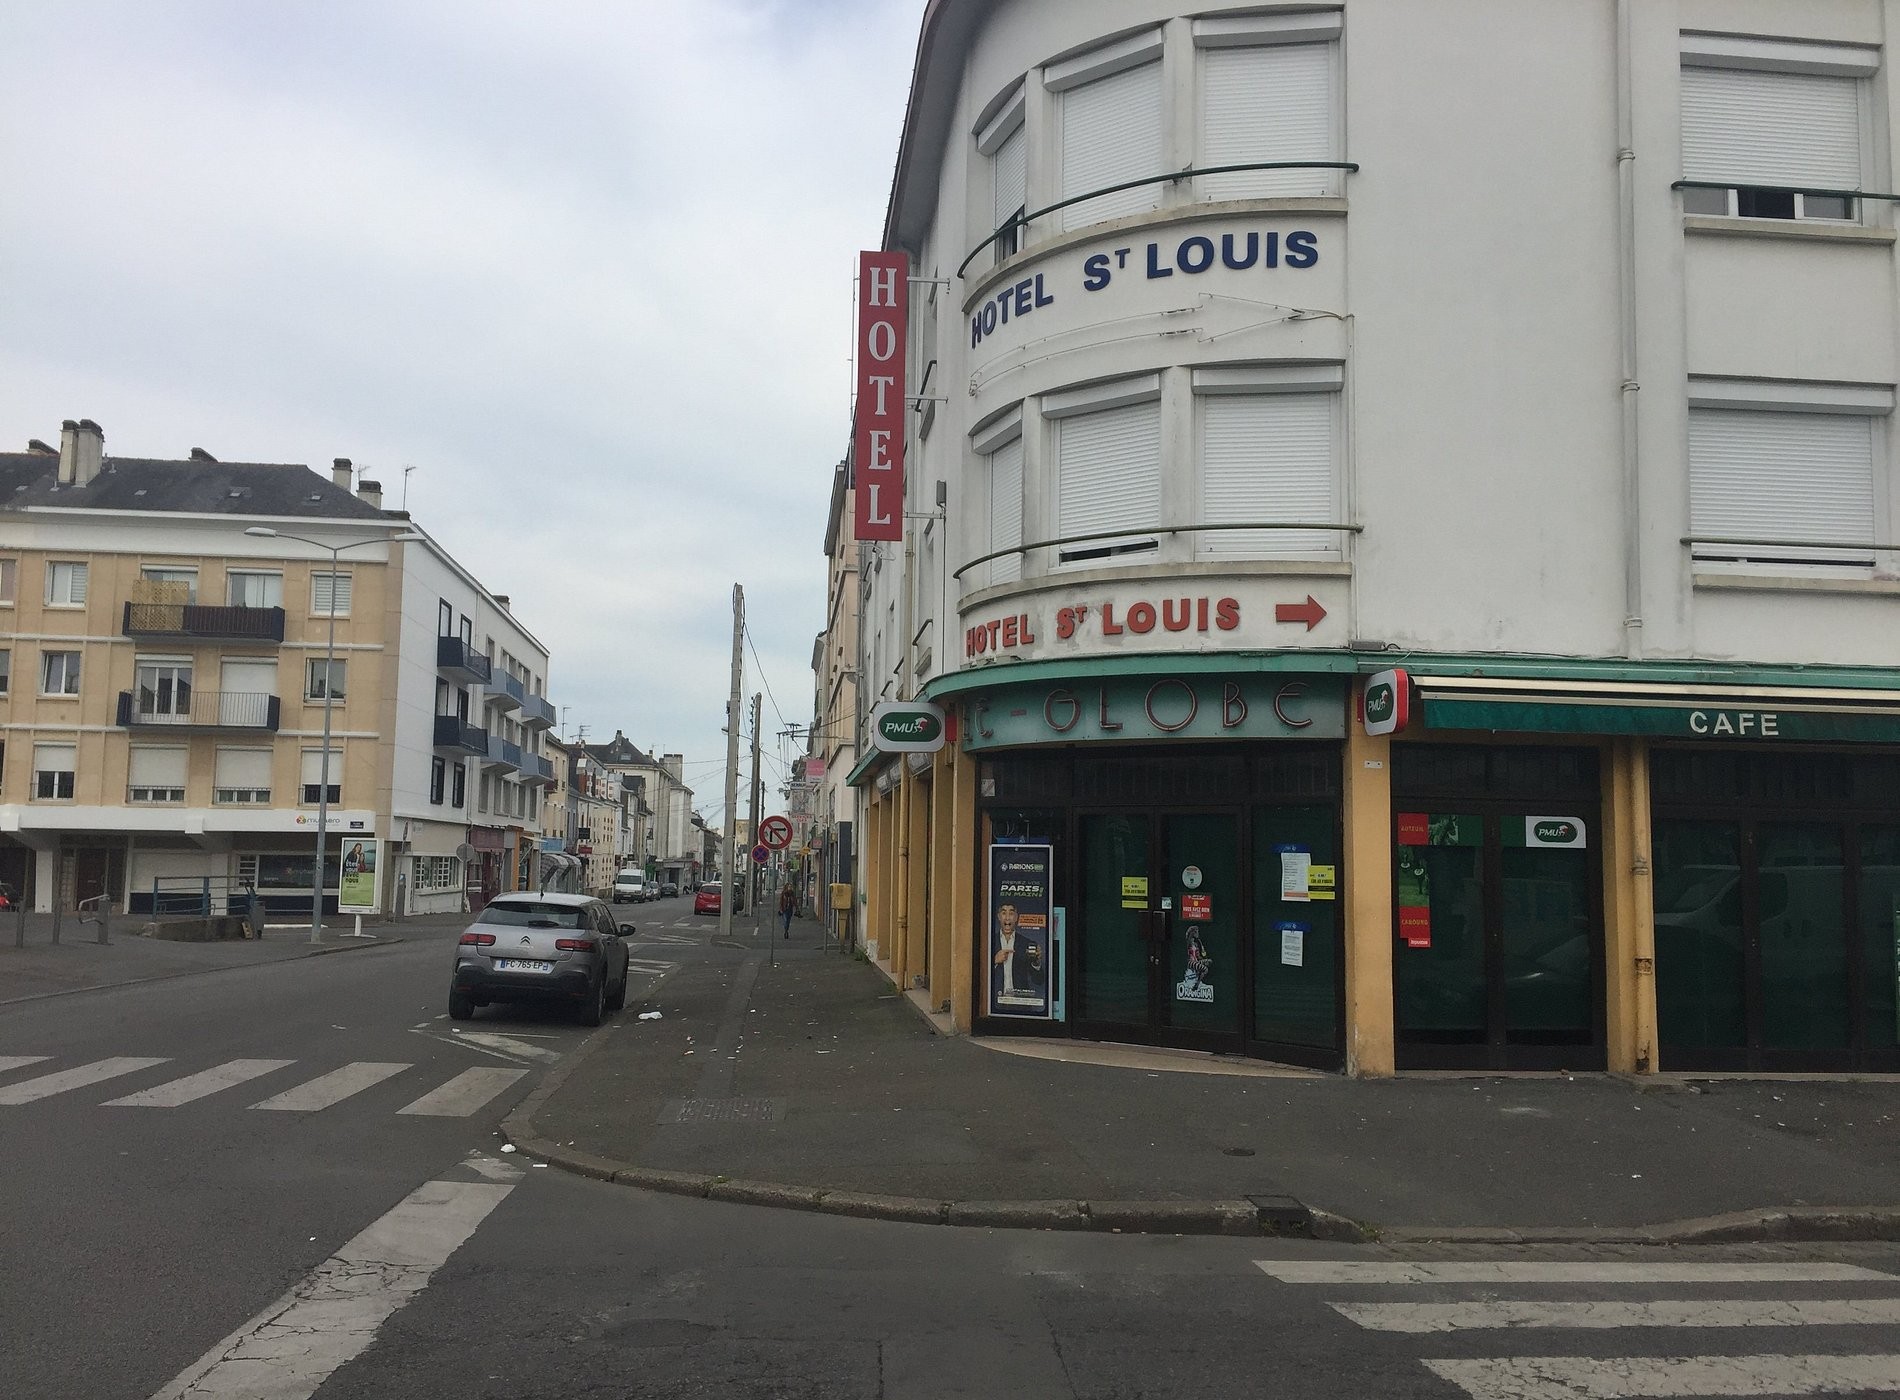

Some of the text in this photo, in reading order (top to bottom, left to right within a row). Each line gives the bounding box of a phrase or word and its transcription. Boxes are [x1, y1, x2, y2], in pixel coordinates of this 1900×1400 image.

[971, 272, 1054, 349] HOTEL
[1147, 231, 1319, 279] LOUIS
[867, 266, 898, 525] HOTEL
[966, 614, 1035, 658] HOTEL
[1103, 597, 1240, 636] LOUIS
[1043, 679, 1314, 734] GLOBE
[1368, 699, 1382, 713] PMU
[1689, 711, 1780, 736] CAFE
[885, 722, 914, 734] PMU
[1538, 827, 1560, 837] PMU
